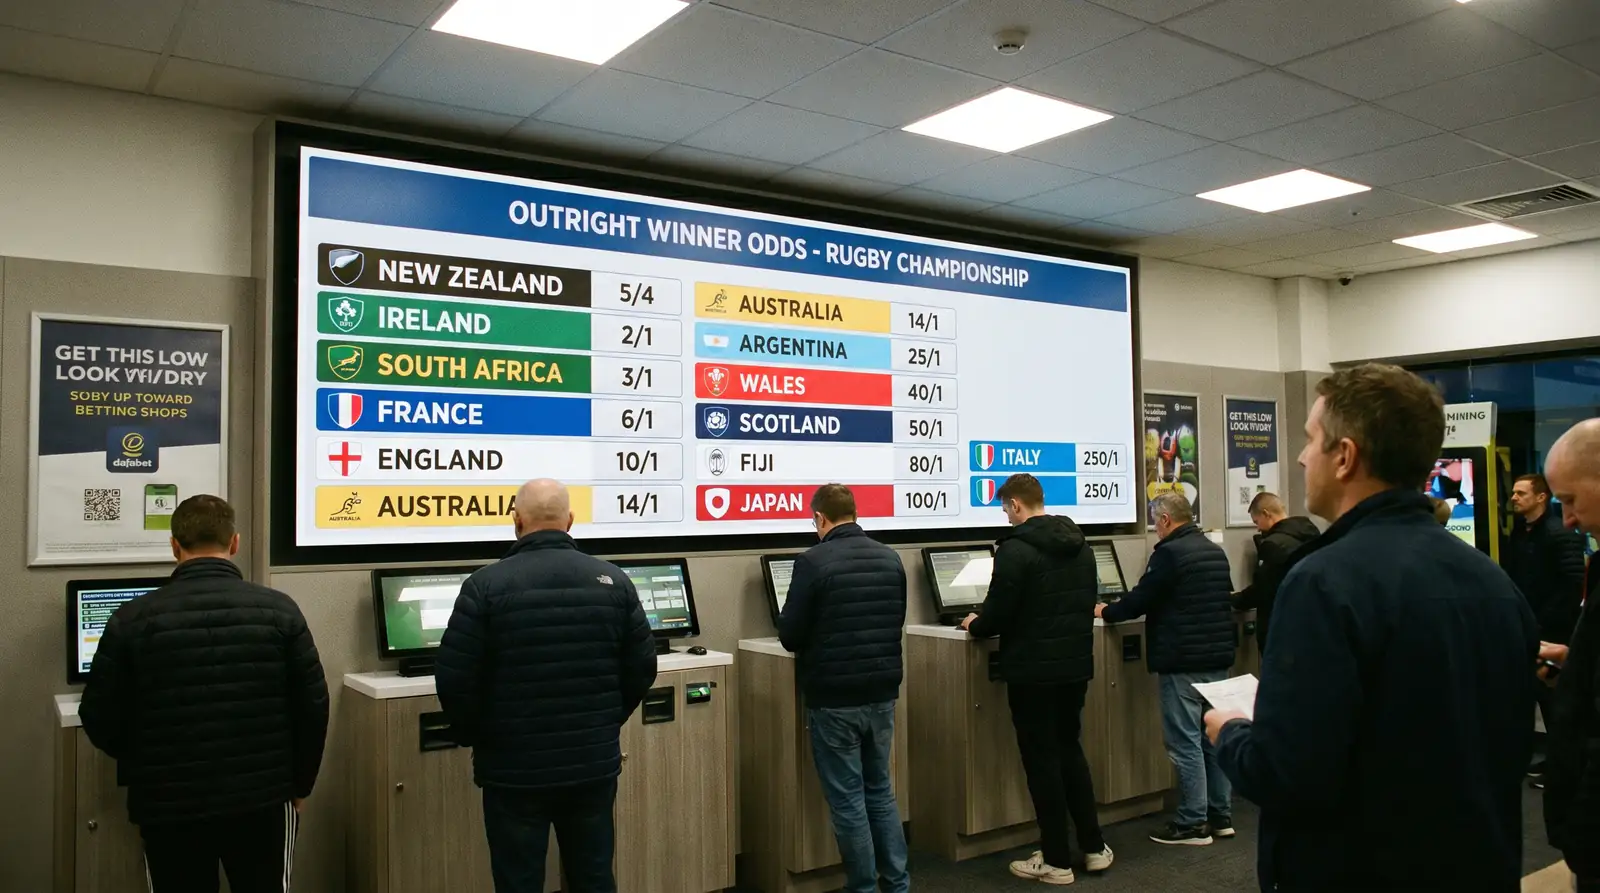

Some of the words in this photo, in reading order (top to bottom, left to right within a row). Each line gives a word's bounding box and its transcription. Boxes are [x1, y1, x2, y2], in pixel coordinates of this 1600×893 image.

[509, 200, 641, 239] OUTRIGHT
[647, 217, 743, 252] WINNER
[747, 232, 807, 260] ODDS
[826, 241, 892, 271] RUGBY
[897, 251, 1029, 287] CHAMPIONSHIP
[378, 258, 440, 284] NEW
[448, 265, 563, 297] ZEALAND
[619, 282, 655, 306] 5/4
[739, 295, 843, 322] AUSTRALIA
[379, 306, 491, 335] IRELAND
[908, 311, 939, 331] 14/1
[621, 325, 653, 348] 2/1
[55, 345, 100, 362] GET
[106, 347, 154, 365] THIS
[159, 350, 208, 367] LOW
[739, 335, 848, 359] ARGENTINA
[377, 352, 466, 379] SOUTH
[473, 356, 563, 383] AFRICA
[908, 348, 941, 367] 25/1
[56, 365, 119, 383] LOOK
[621, 367, 653, 389] 3/1
[739, 372, 806, 395] WALES
[70, 391, 109, 401] SOBY
[114, 392, 131, 402] UP
[135, 393, 193, 404] TOWARD
[908, 383, 943, 402] 40/1
[75, 405, 137, 416] BETTING
[140, 408, 188, 418] SHOPS
[378, 400, 483, 425] FRANCE
[621, 408, 654, 431] 6/1
[1229, 412, 1242, 420] GET
[1243, 412, 1257, 421] THIS
[1257, 413, 1272, 422] LOW
[1447, 411, 1486, 421] MINING
[739, 412, 840, 435] SCOTLAND
[908, 419, 943, 438] 50/1
[1230, 422, 1249, 431] LOOK
[113, 458, 152, 468] dafabet
[379, 449, 503, 471] ENGLAND
[617, 451, 659, 474] 10/1
[740, 453, 773, 472] FIJI
[909, 454, 944, 473] 80/1
[1002, 447, 1041, 466] ITALY
[1083, 449, 1119, 467] 250/1
[905, 491, 947, 510] 100/1
[1084, 482, 1120, 500] 250/1
[617, 494, 659, 514] 14/1
[740, 492, 803, 512] JAPAN
